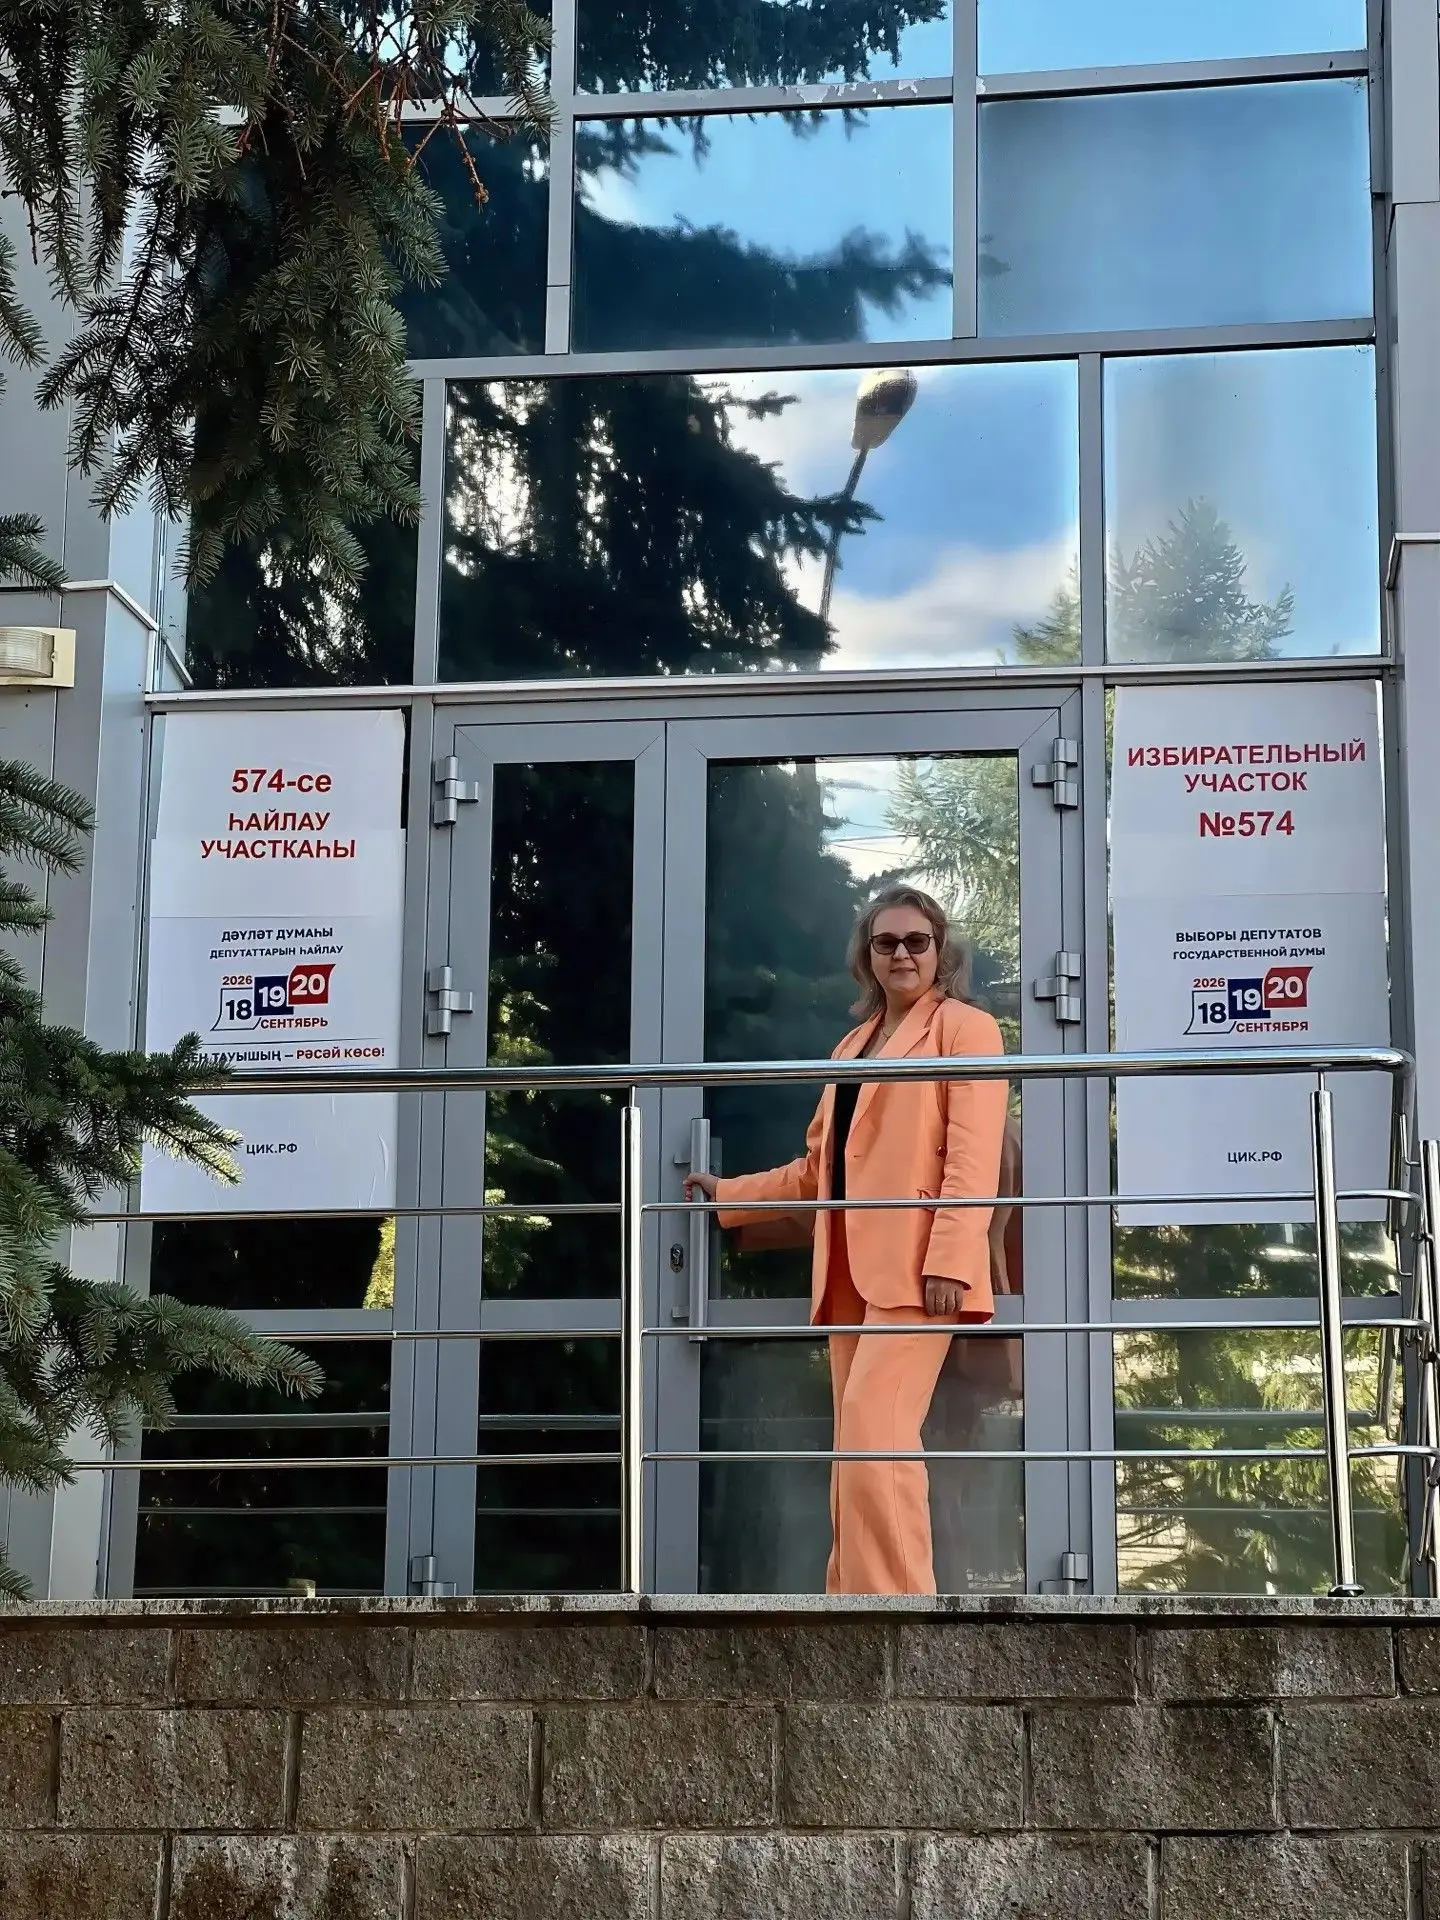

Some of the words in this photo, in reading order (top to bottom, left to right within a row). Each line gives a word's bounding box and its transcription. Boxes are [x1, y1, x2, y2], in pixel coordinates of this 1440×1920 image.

[1128, 738, 1366, 767] ИЗБИРАТЕЛЬНЫЙ
[231, 768, 332, 793] 574-се
[1185, 771, 1308, 793] УЧАСТОК
[1199, 810, 1295, 837] №574
[201, 839, 355, 859] УЧАСТКАҺЫ
[276, 928, 333, 940] ДУМАҺЫ
[1176, 931, 1237, 943] ВЫБОРЫ
[1240, 928, 1322, 942] ДЕПУТАТОВ
[209, 948, 296, 959] ДЕПУТАТТАРЫН
[1173, 946, 1286, 960] ГОСУДАРСТВЕННОЙ
[1290, 947, 1325, 958] ДУМЫ
[222, 975, 252, 985] 2026
[1193, 978, 1225, 988] 2026
[226, 999, 252, 1020] 18
[258, 986, 286, 1007] 19
[292, 974, 325, 995] 20
[1198, 1002, 1227, 1024] 18
[1232, 989, 1261, 1011] 19
[1268, 976, 1303, 999] 20
[260, 1018, 328, 1028] СЕНТЯБРЬ
[1236, 1021, 1309, 1033] СЕНТЯБРЯ
[296, 1046, 340, 1060] РӘСӘЙ
[344, 1047, 385, 1058] КӨСӨ!
[246, 1141, 298, 1155] ЦИК.РФ
[1227, 1151, 1283, 1163] ЦИК.РФ
